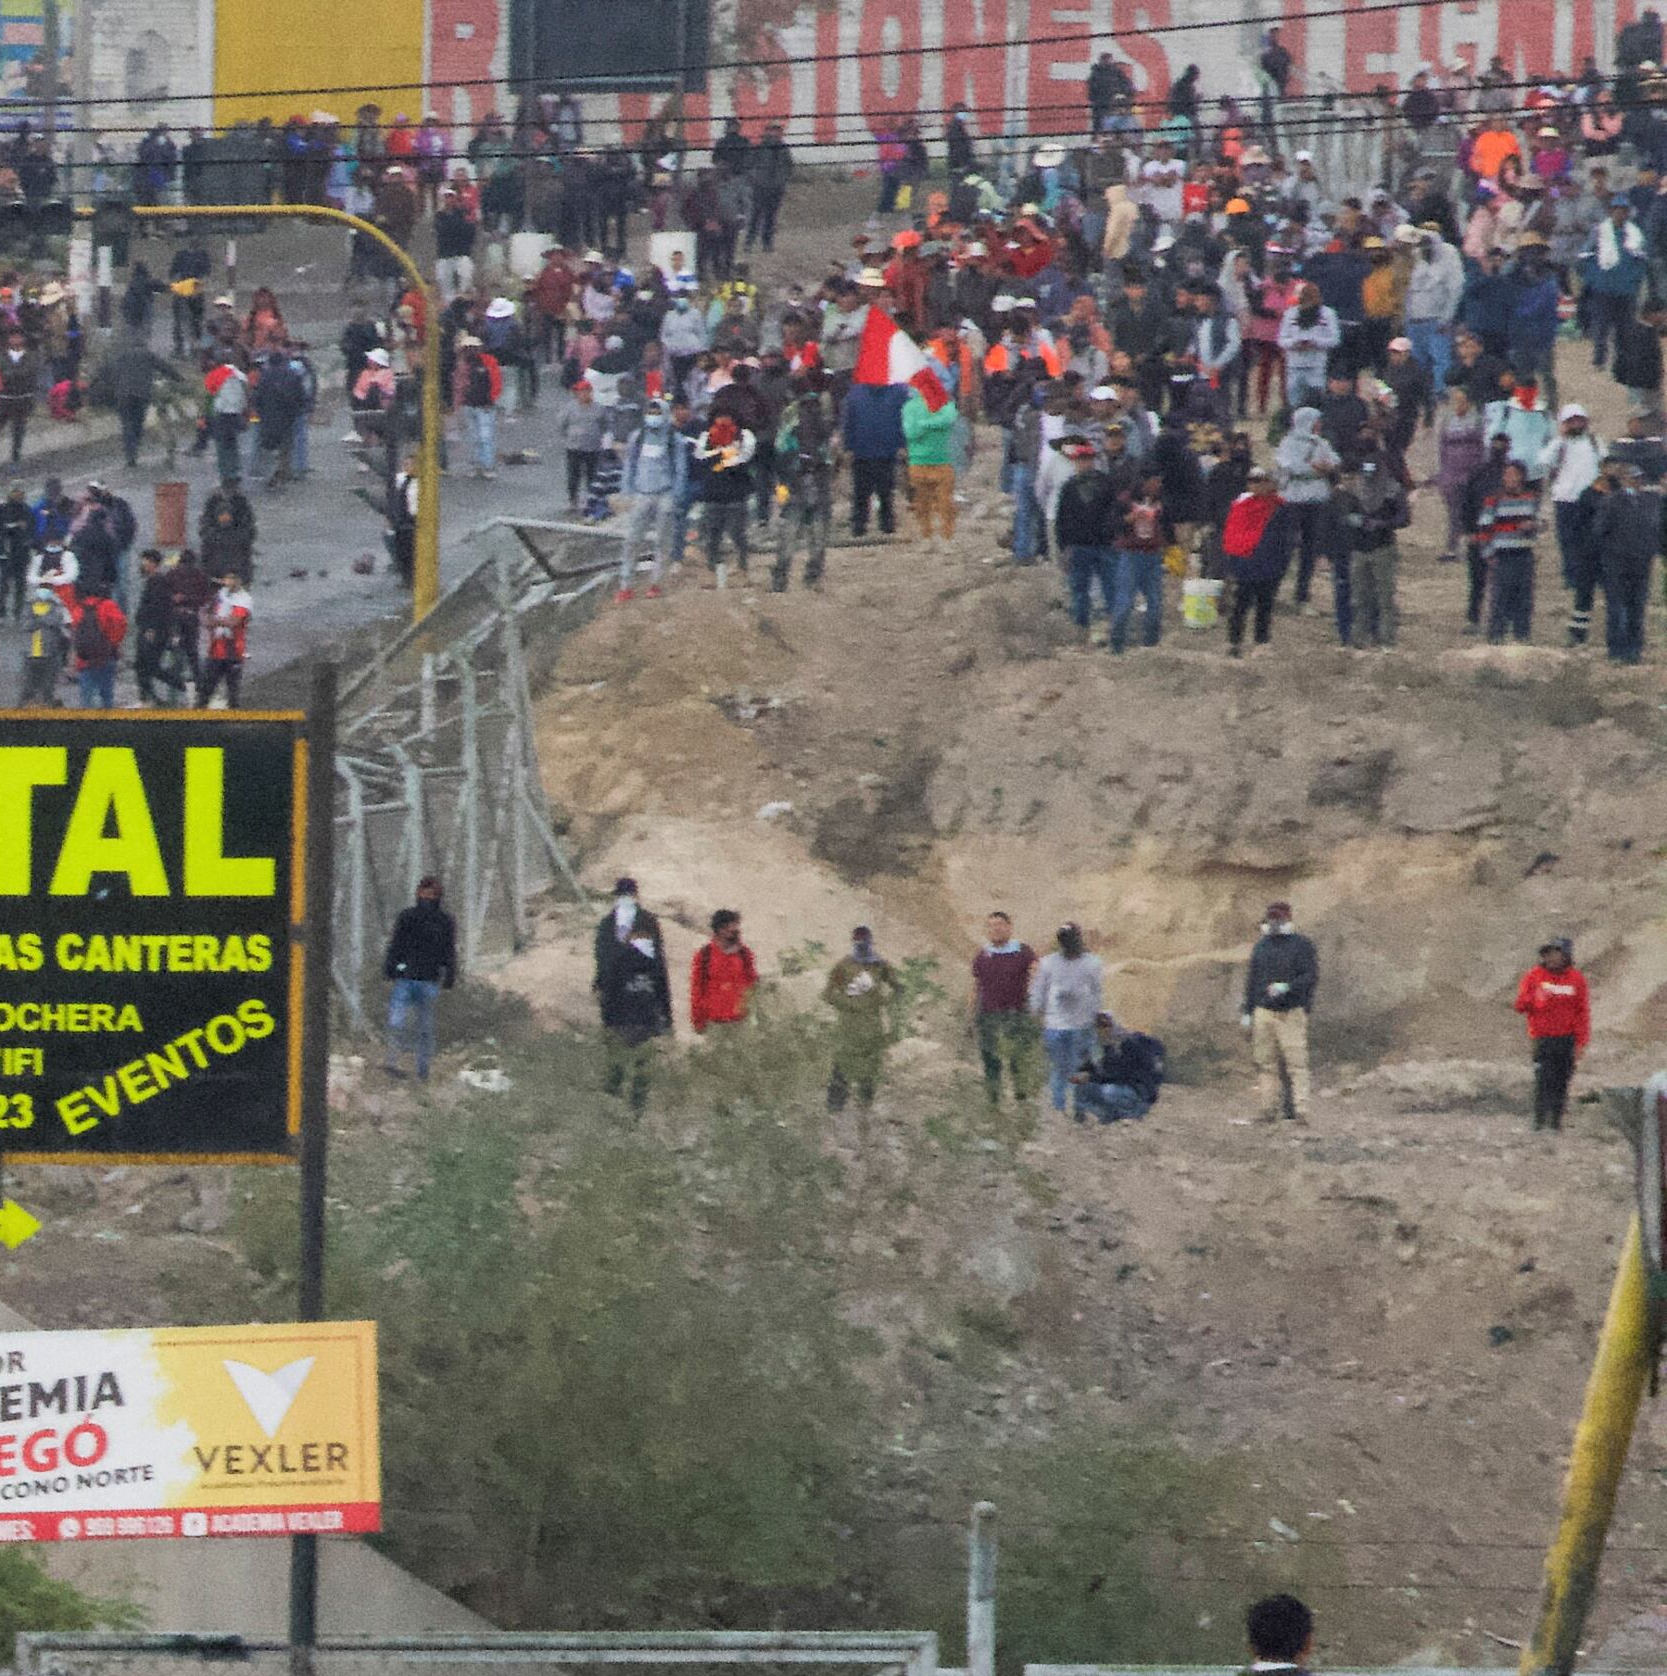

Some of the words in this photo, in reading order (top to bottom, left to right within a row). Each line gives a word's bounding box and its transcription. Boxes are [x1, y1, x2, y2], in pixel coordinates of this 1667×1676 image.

[56, 933, 272, 972] CANTERAS
[54, 998, 276, 1136] EVENTOS
[193, 1441, 349, 1475] VEXLER
[0, 1476, 69, 1501] CONO
[76, 1464, 155, 1490] NORTE
